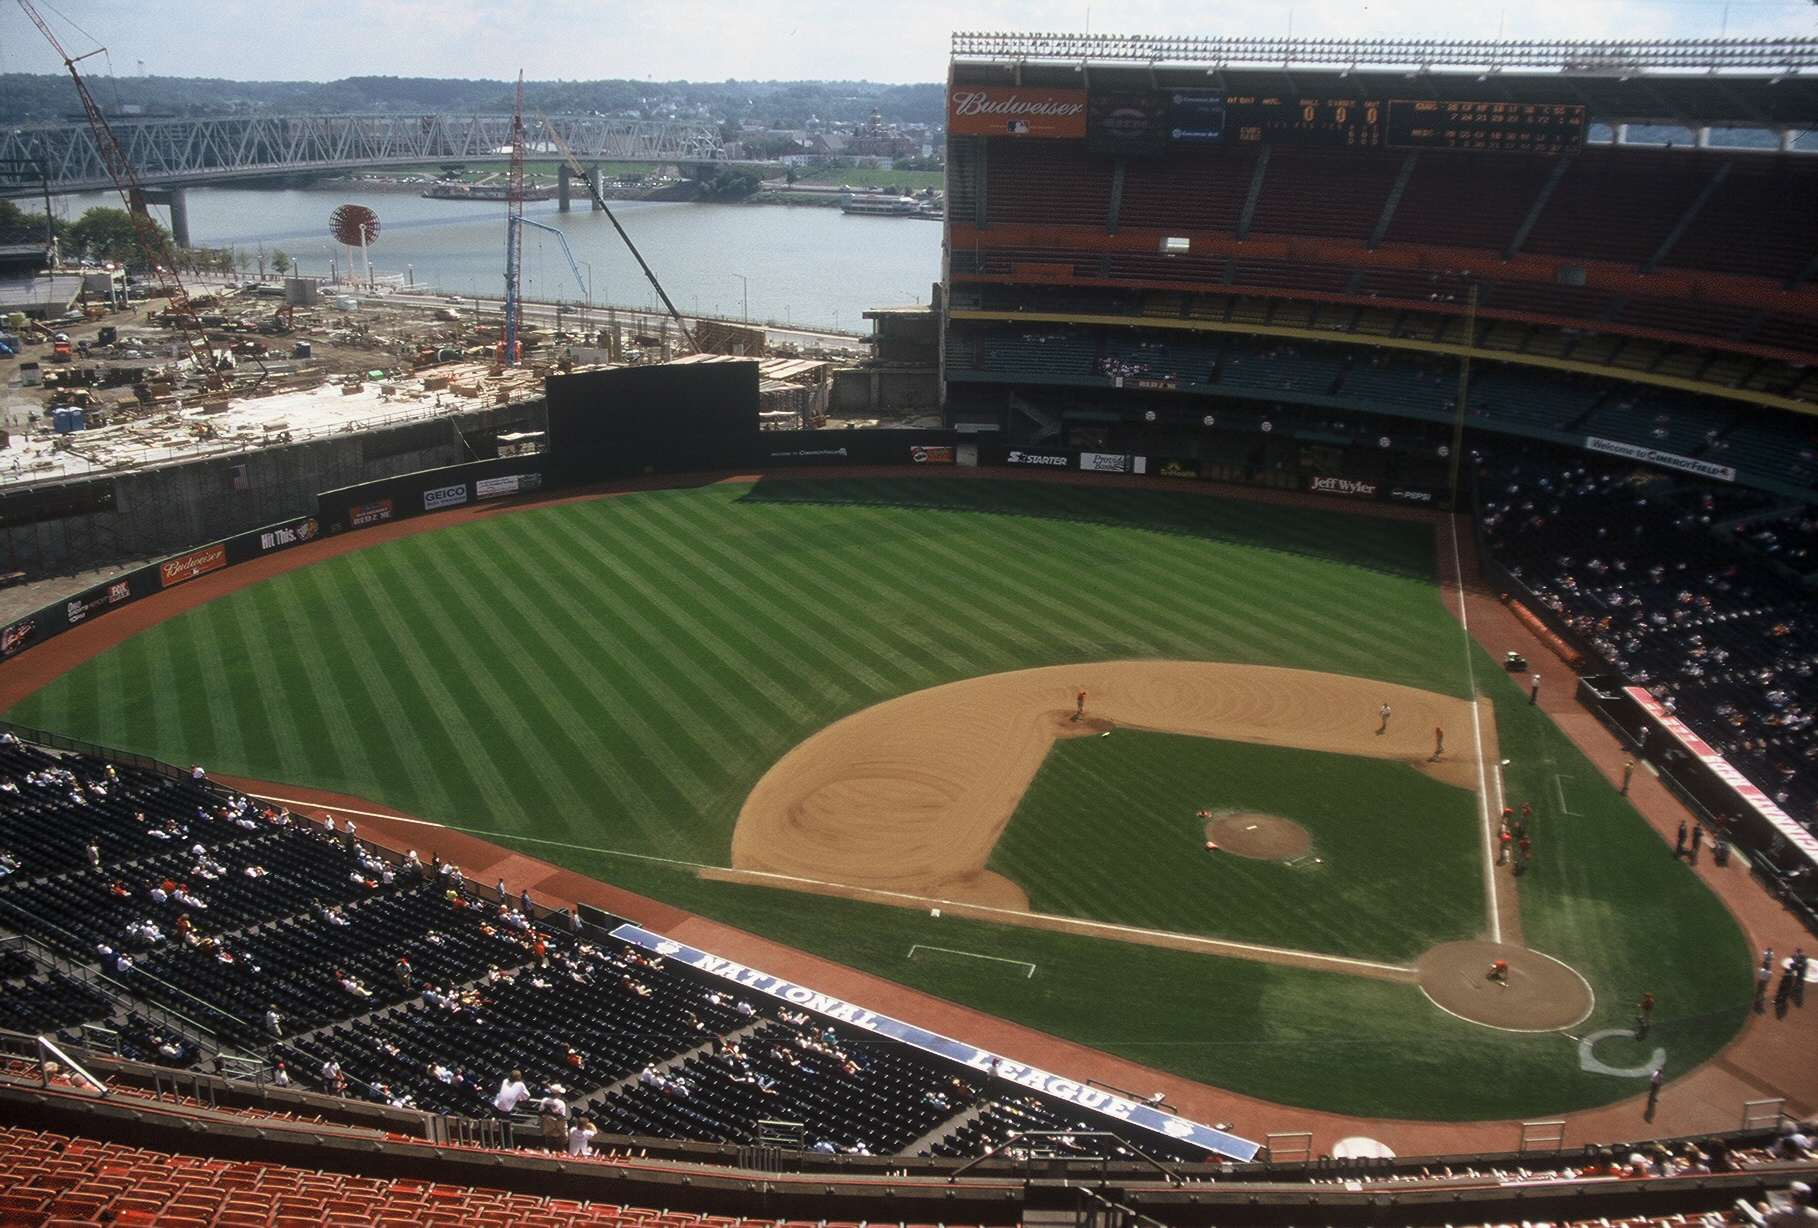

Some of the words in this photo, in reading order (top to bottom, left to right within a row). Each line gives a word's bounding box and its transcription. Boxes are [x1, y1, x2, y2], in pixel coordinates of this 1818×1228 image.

[952, 91, 1084, 116] Budweiser
[1304, 106, 1314, 121] 0
[1336, 107, 1346, 122] 0
[1367, 108, 1377, 124] 0
[1592, 439, 1634, 455] Welcome
[1636, 449, 1646, 458] to
[1026, 455, 1067, 466] STARTER
[1093, 454, 1125, 464] Provide
[1311, 476, 1338, 490] Jeff
[1339, 479, 1376, 494] Wyler
[426, 487, 465, 501] GEICO
[1404, 491, 1431, 501] PEPSI
[353, 515, 372, 525] RED
[261, 533, 275, 550] Hit
[275, 528, 297, 545] This.
[164, 550, 222, 578] Budweiser
[111, 582, 128, 596] FOX
[692, 953, 879, 1030] NATIONAL
[967, 1050, 1138, 1120] LEAGUE
